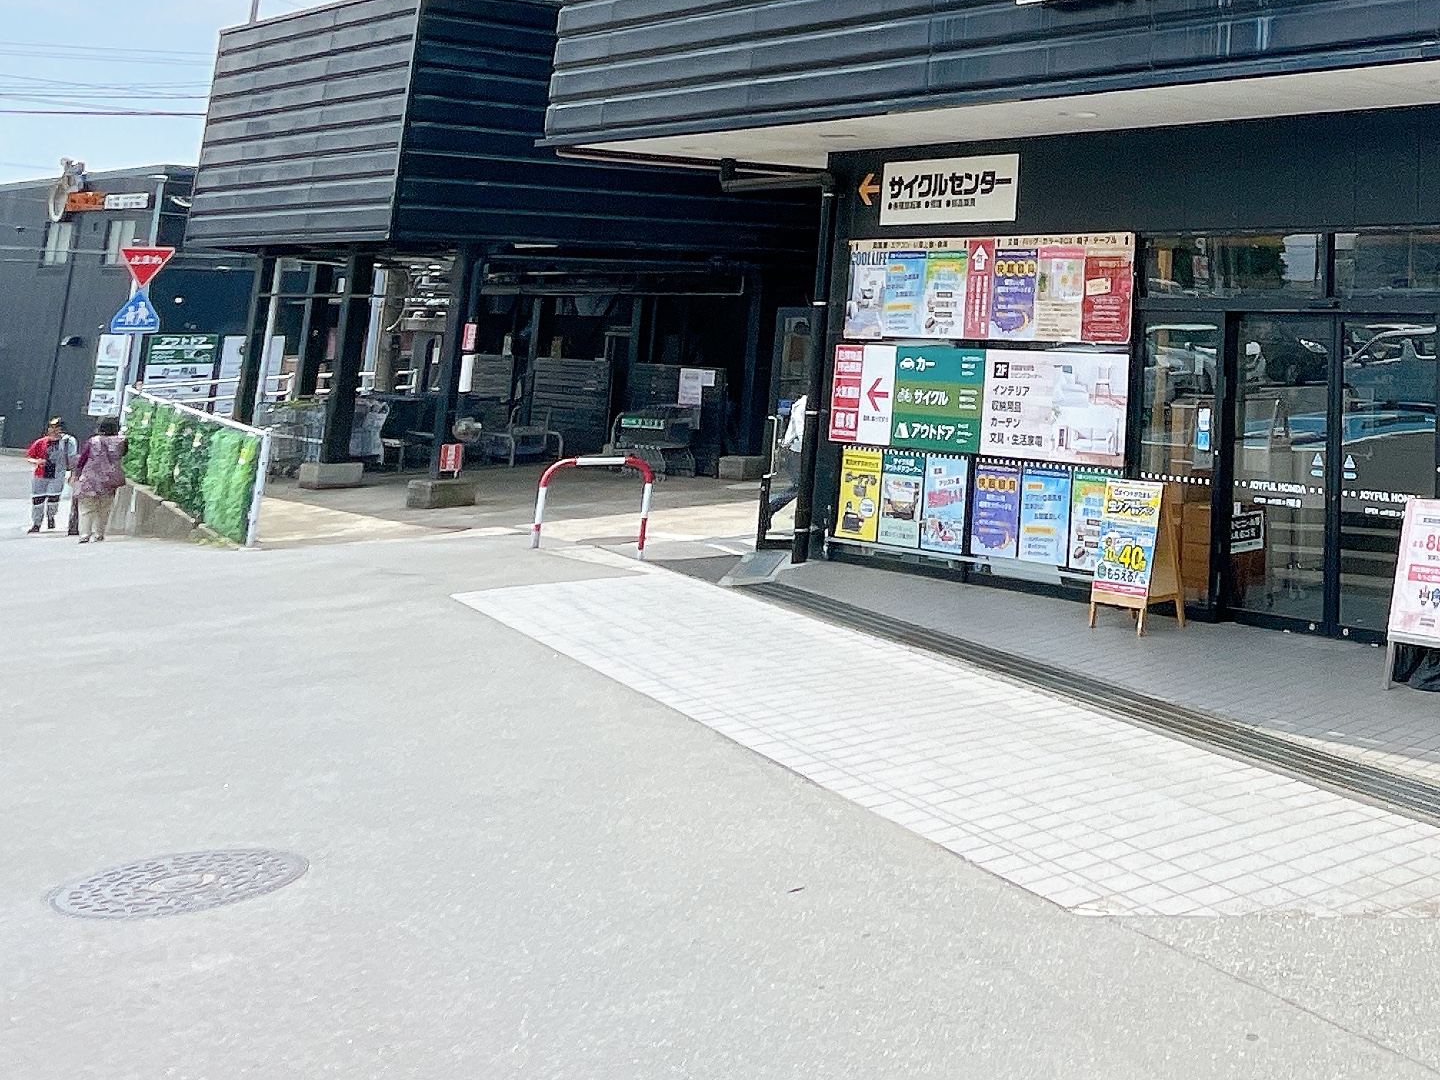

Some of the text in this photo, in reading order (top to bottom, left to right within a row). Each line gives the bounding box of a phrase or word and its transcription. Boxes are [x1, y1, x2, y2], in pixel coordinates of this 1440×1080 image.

[889, 170, 1013, 199] サイクルセンター
[916, 356, 936, 372] カー
[996, 363, 1008, 377] 2F
[914, 389, 949, 406] サイクル
[993, 384, 1030, 397] インテリア
[990, 417, 1021, 429] カーテン
[911, 422, 955, 441] アウトドア
[1249, 480, 1307, 494] JOYFUL HONDA
[1359, 490, 1421, 503] JOYFUL HON
